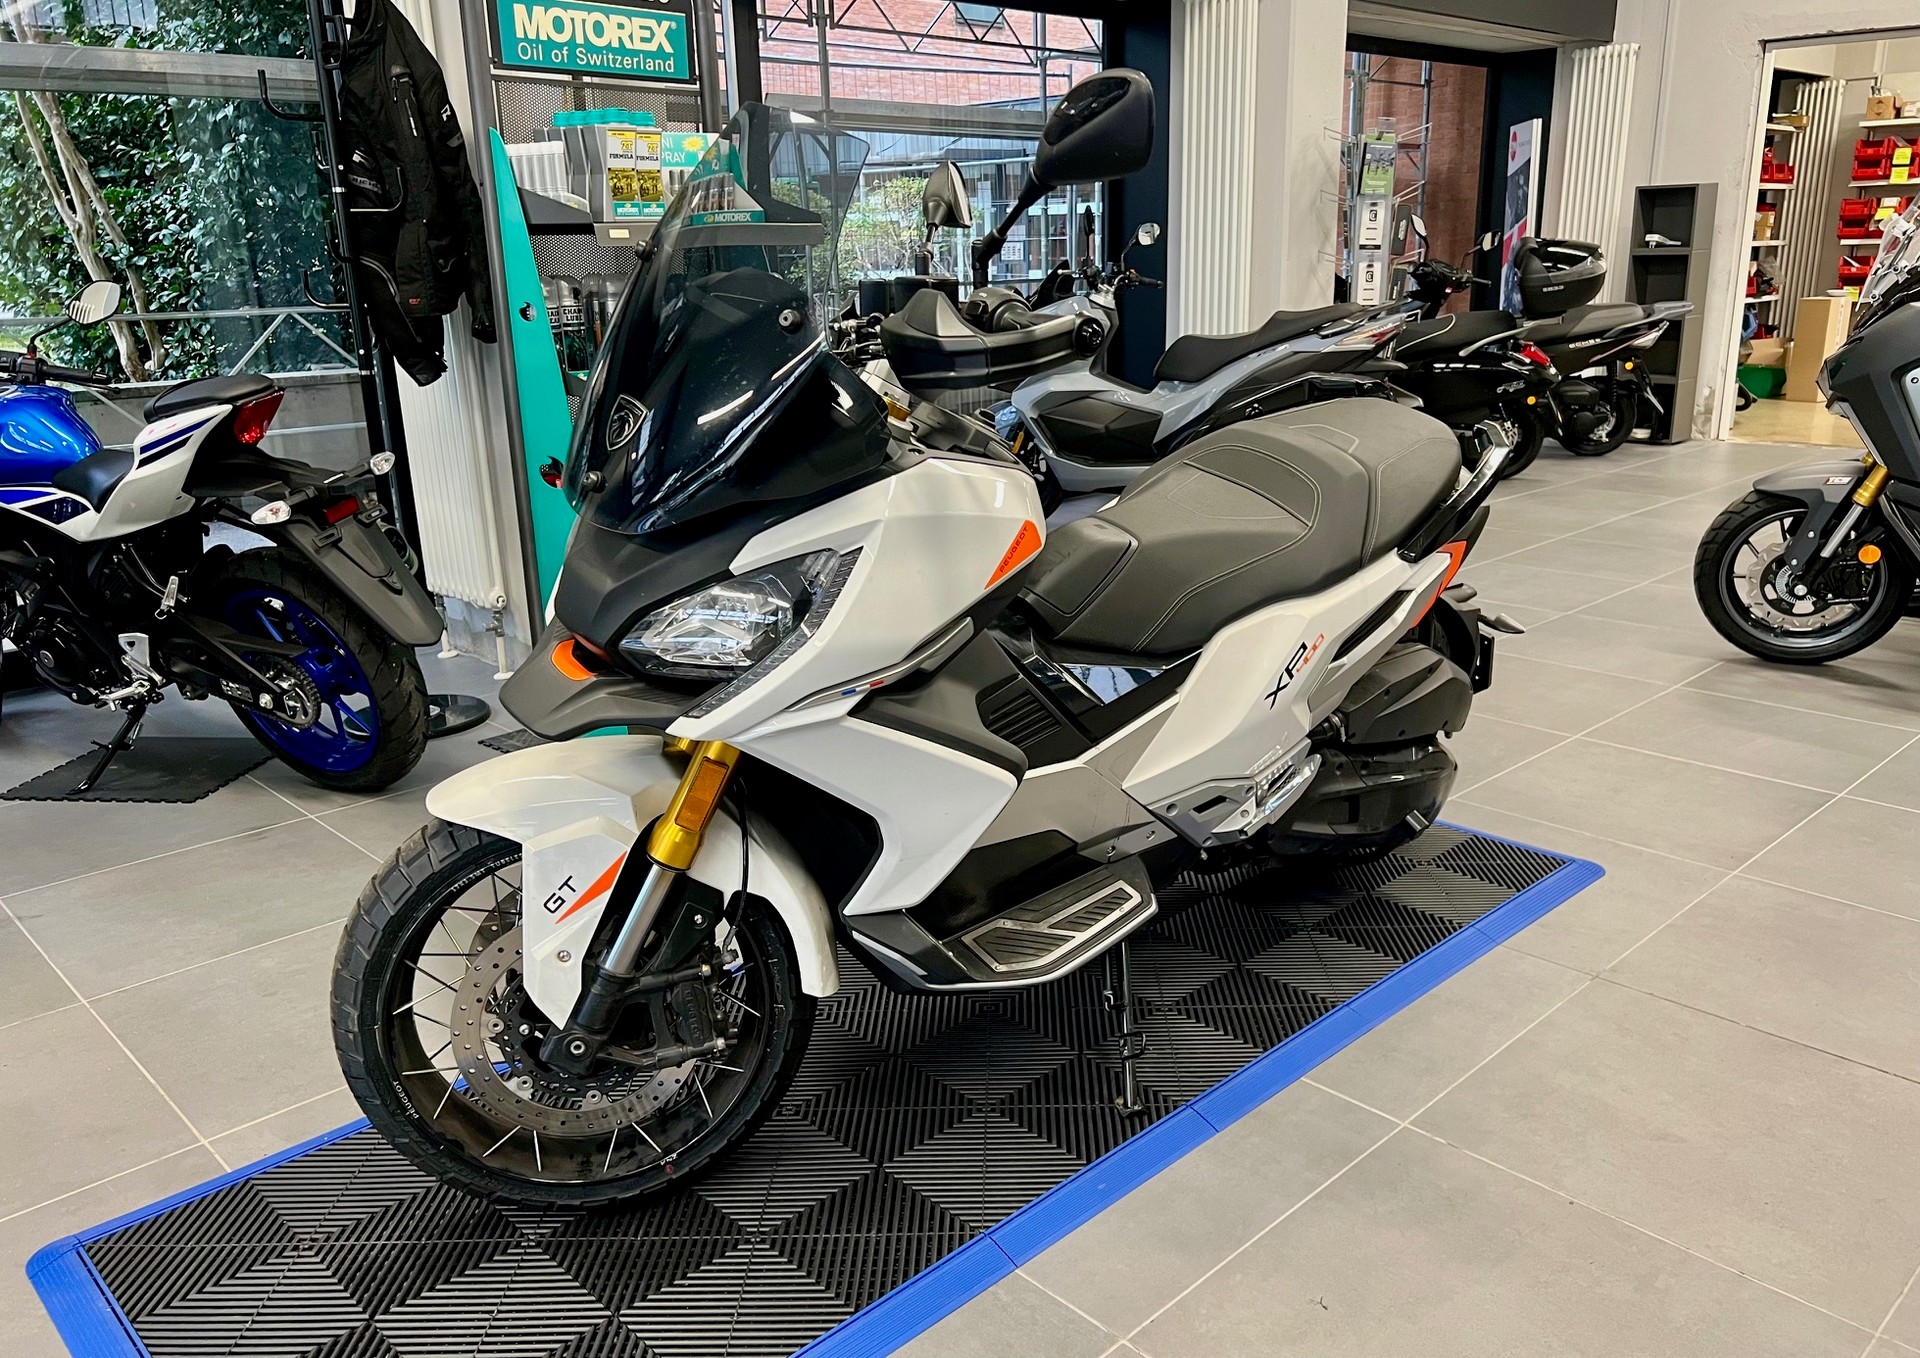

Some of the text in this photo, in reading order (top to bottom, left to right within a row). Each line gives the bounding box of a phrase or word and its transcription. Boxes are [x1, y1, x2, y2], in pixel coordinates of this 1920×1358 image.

[512, 3, 674, 54] MOTOREX
[517, 42, 674, 73] Oil of Switzerland
[714, 213, 752, 222] MOTOREX
[999, 525, 1029, 574] PEUGEOT
[1263, 641, 1308, 711] XP
[543, 875, 578, 914] GT
[392, 1081, 420, 1119] PEUGEOT
